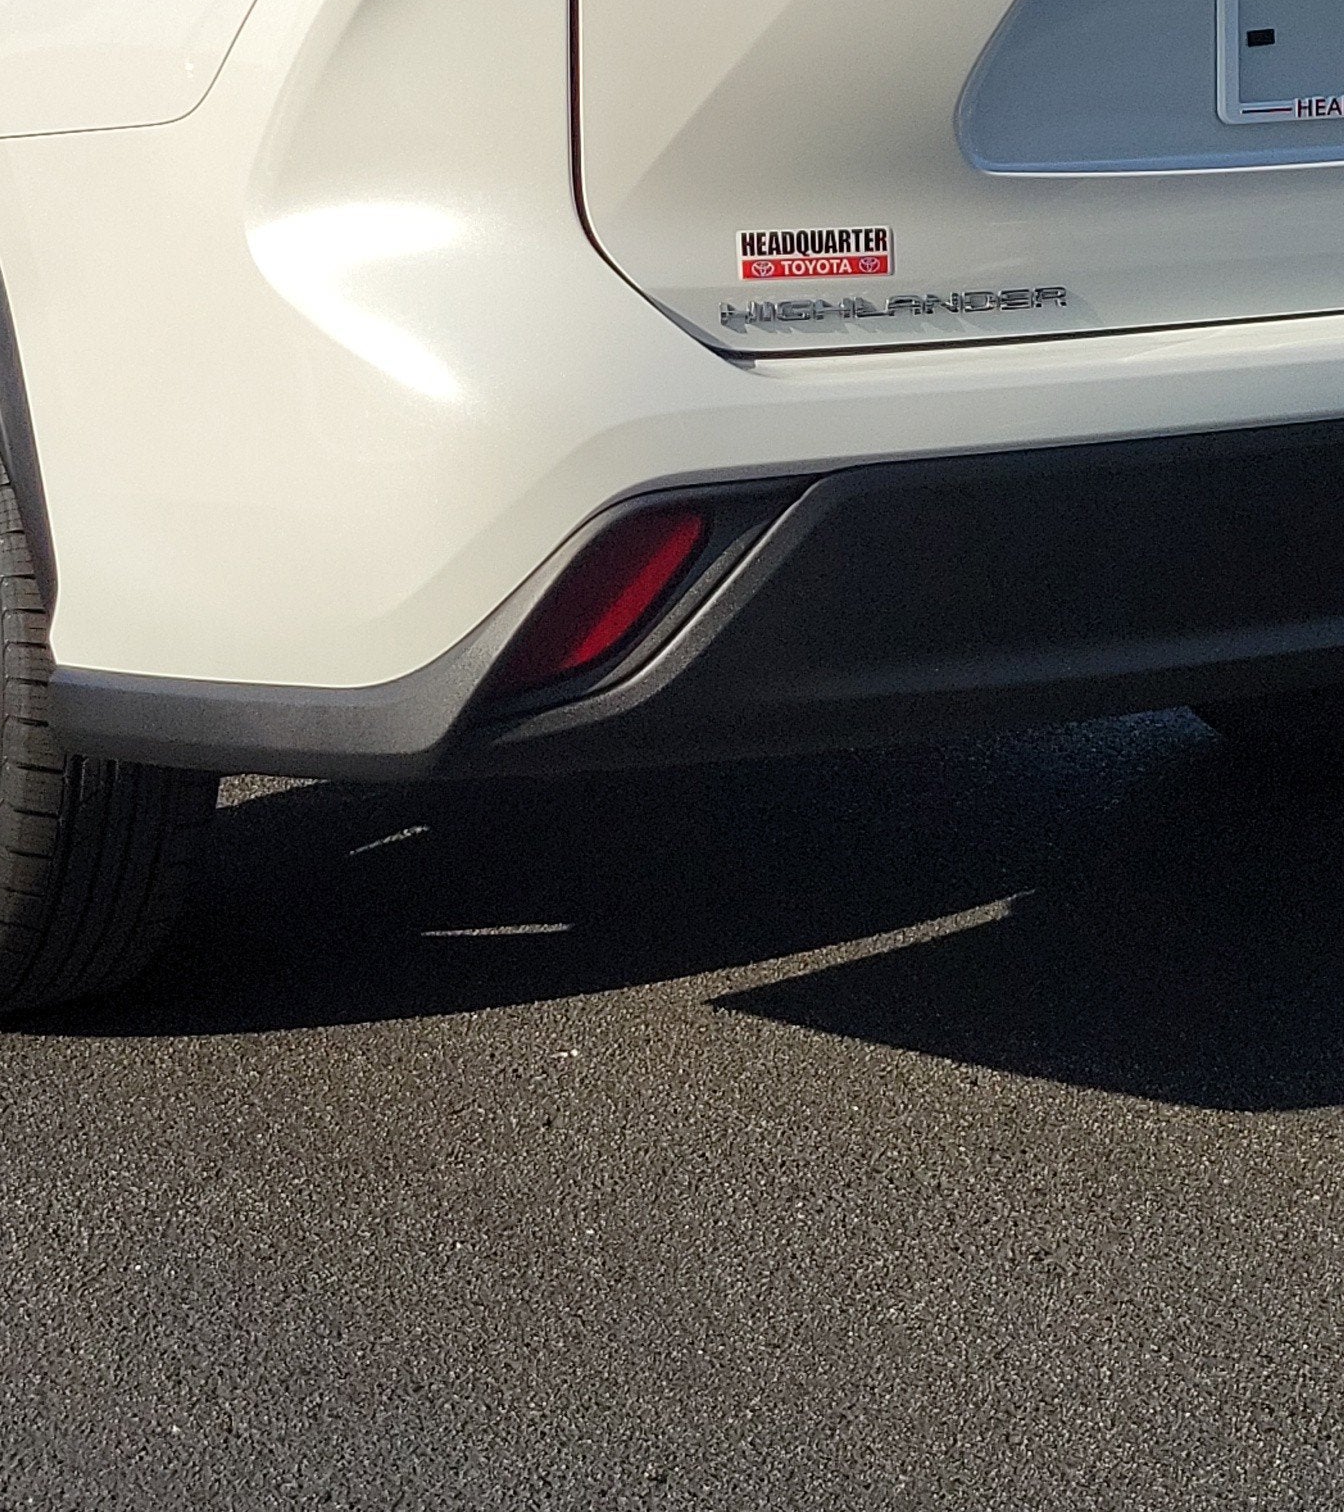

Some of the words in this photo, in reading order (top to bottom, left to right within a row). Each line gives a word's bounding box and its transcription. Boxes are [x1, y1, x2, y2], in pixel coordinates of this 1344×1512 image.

[741, 227, 888, 257] HEADQUARTER
[781, 259, 853, 276] TOYOTA
[720, 286, 1068, 326] HIGHLANDER
